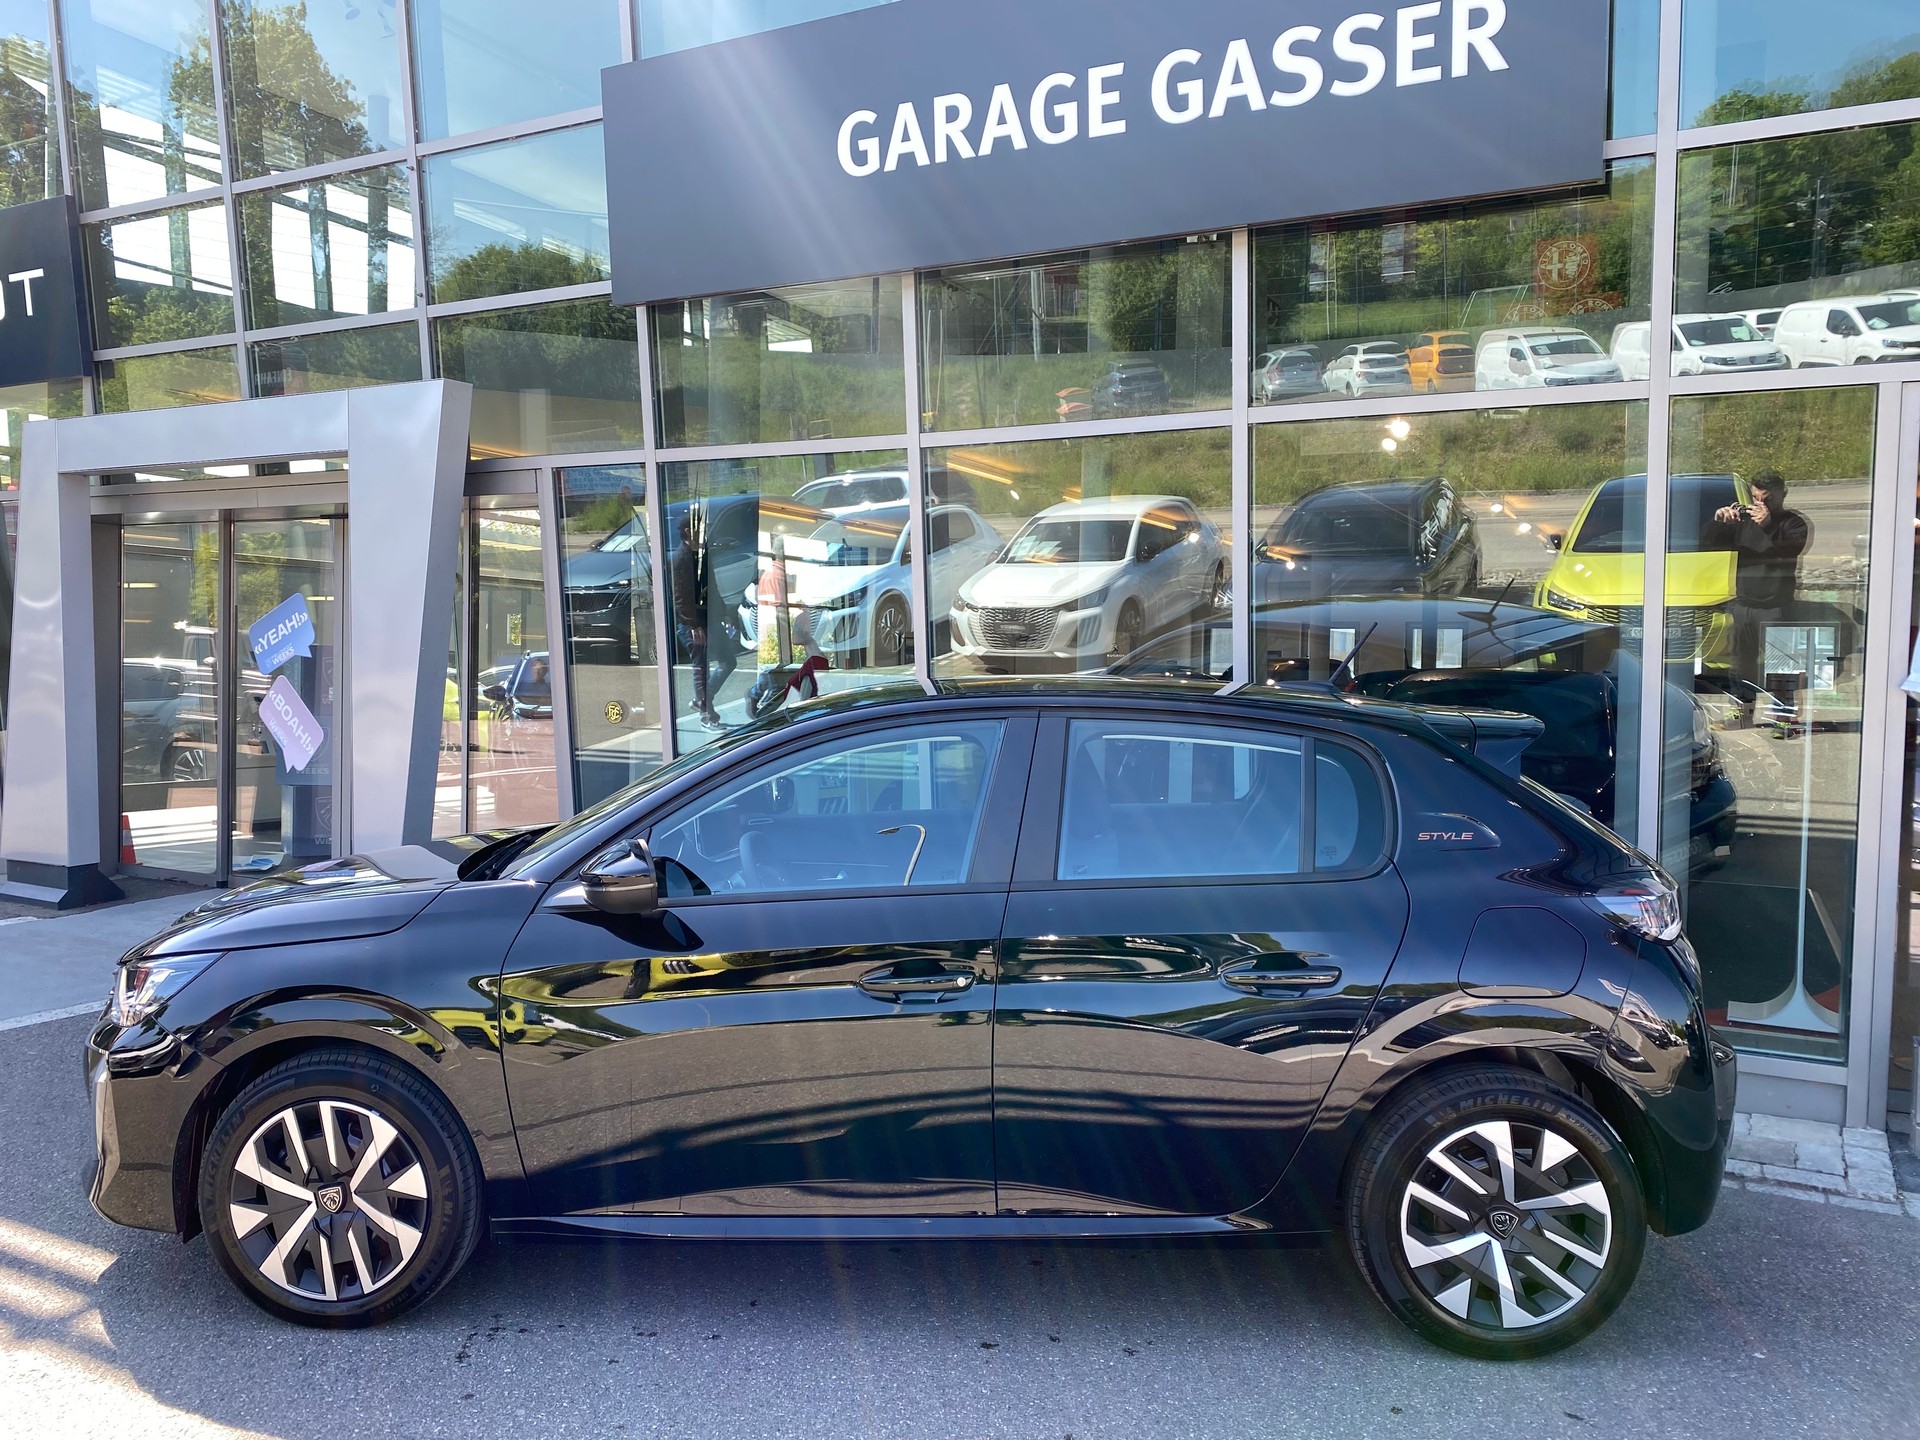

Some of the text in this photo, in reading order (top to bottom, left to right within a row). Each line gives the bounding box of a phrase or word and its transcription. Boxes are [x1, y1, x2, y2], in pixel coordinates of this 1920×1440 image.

[836, 0, 1511, 178] GARAGE GASSER
[0, 268, 45, 320] T
[1417, 832, 1474, 841] STYLE
[1458, 1093, 1555, 1113] MICHELIN
